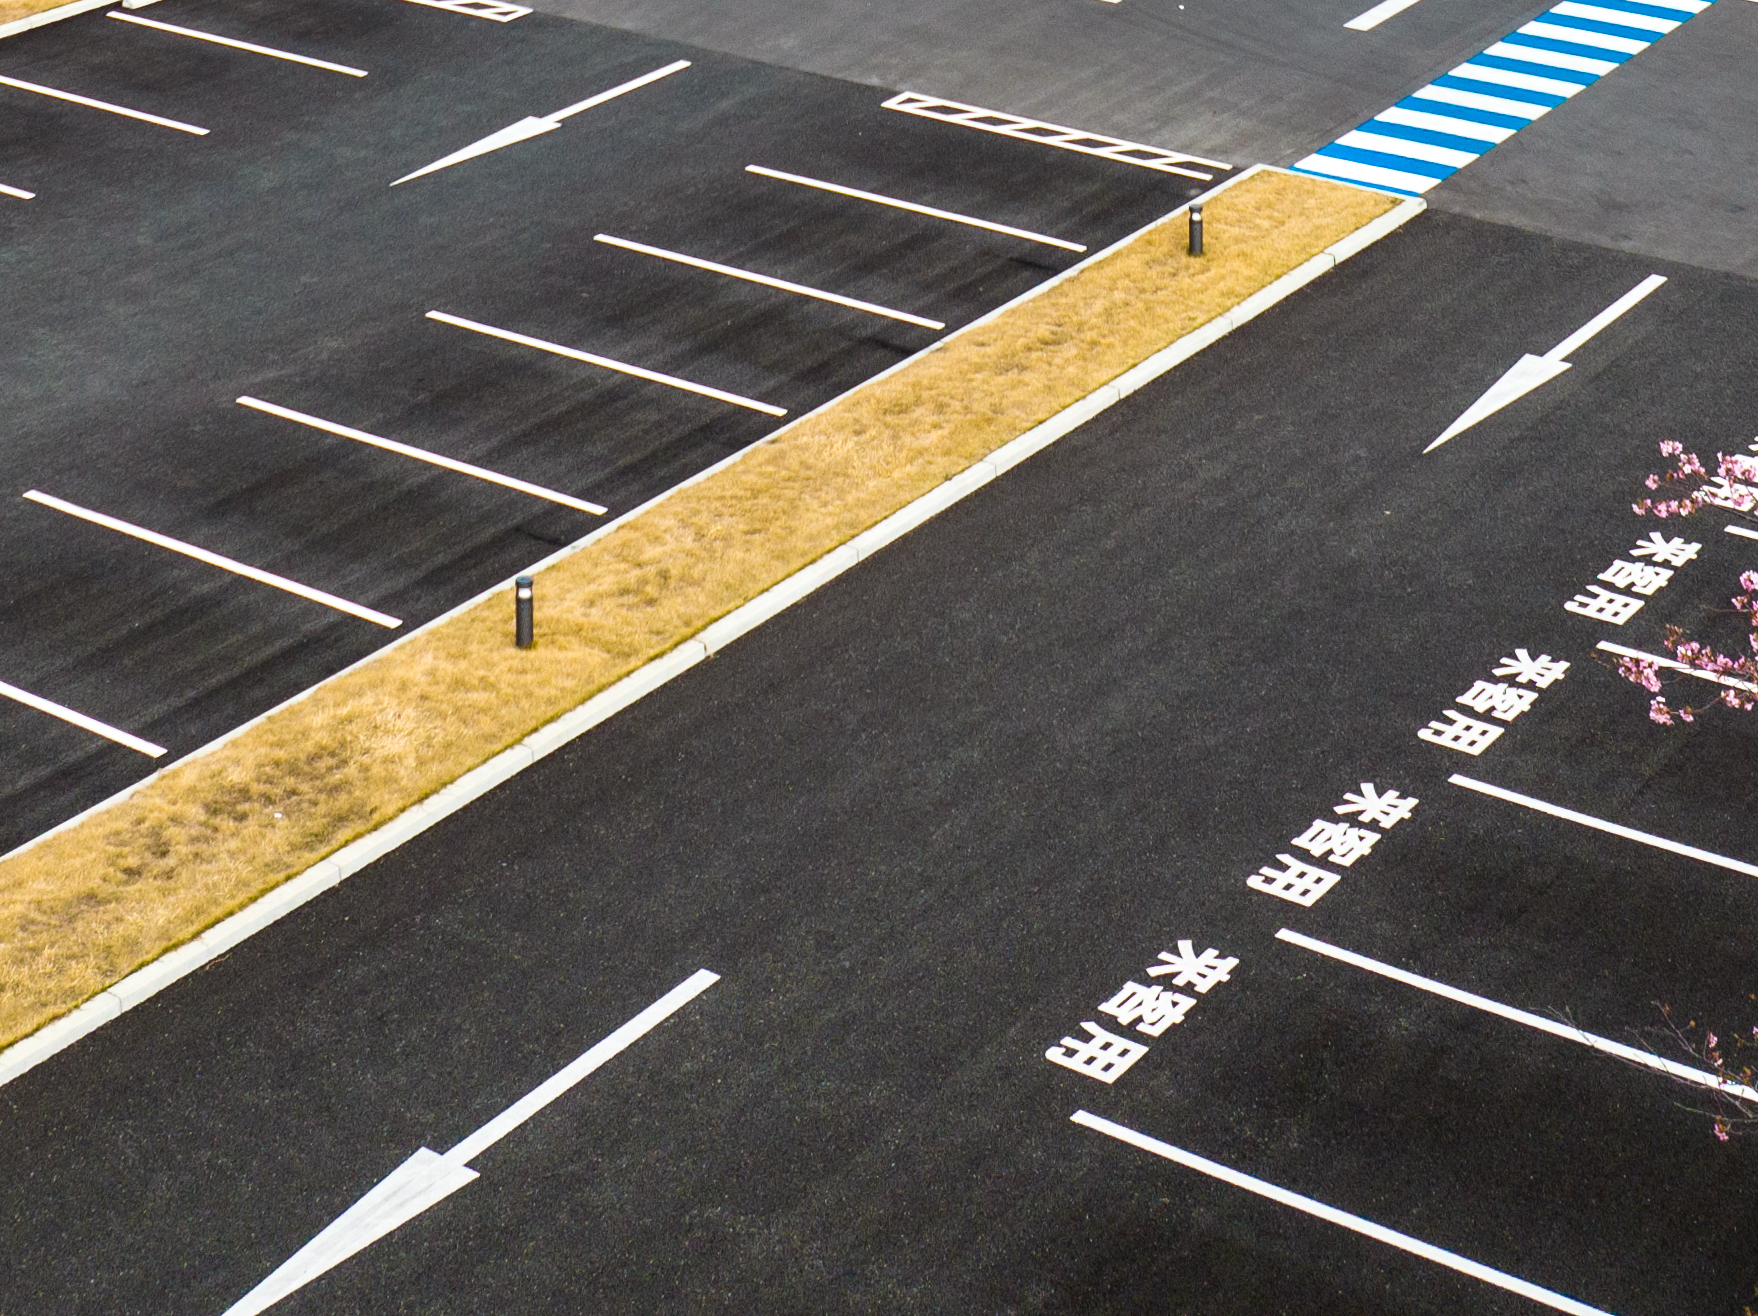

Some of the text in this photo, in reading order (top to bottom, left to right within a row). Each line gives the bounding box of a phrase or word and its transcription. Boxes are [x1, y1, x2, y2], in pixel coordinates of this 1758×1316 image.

[1564, 531, 1703, 625] 来客用
[1418, 649, 1571, 755] 来客用
[1246, 783, 1420, 907] 来客用
[1045, 939, 1240, 1084] 来客用
